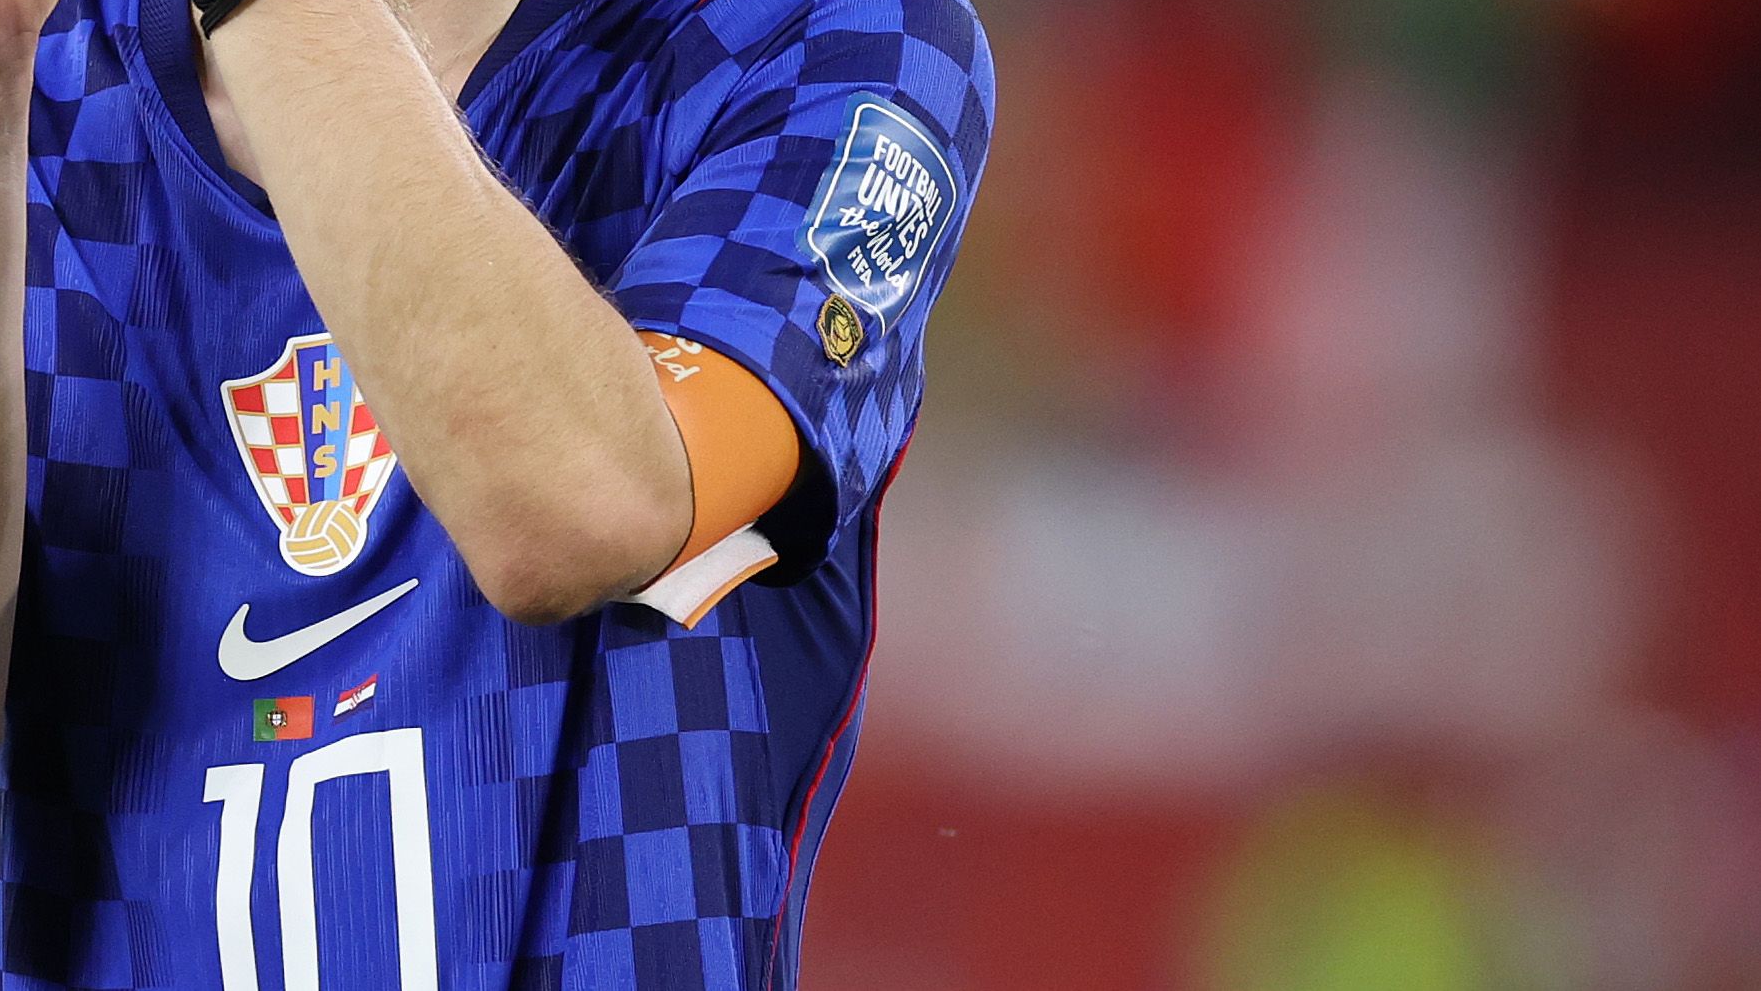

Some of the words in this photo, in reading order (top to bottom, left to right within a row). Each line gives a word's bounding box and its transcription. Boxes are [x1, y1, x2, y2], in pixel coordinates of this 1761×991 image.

[857, 162, 929, 259] UNITES
[873, 133, 942, 226] FOOTBALL
[839, 207, 880, 237] the
[866, 223, 911, 296] World
[847, 245, 873, 290] FIFA
[202, 727, 440, 991] 10
